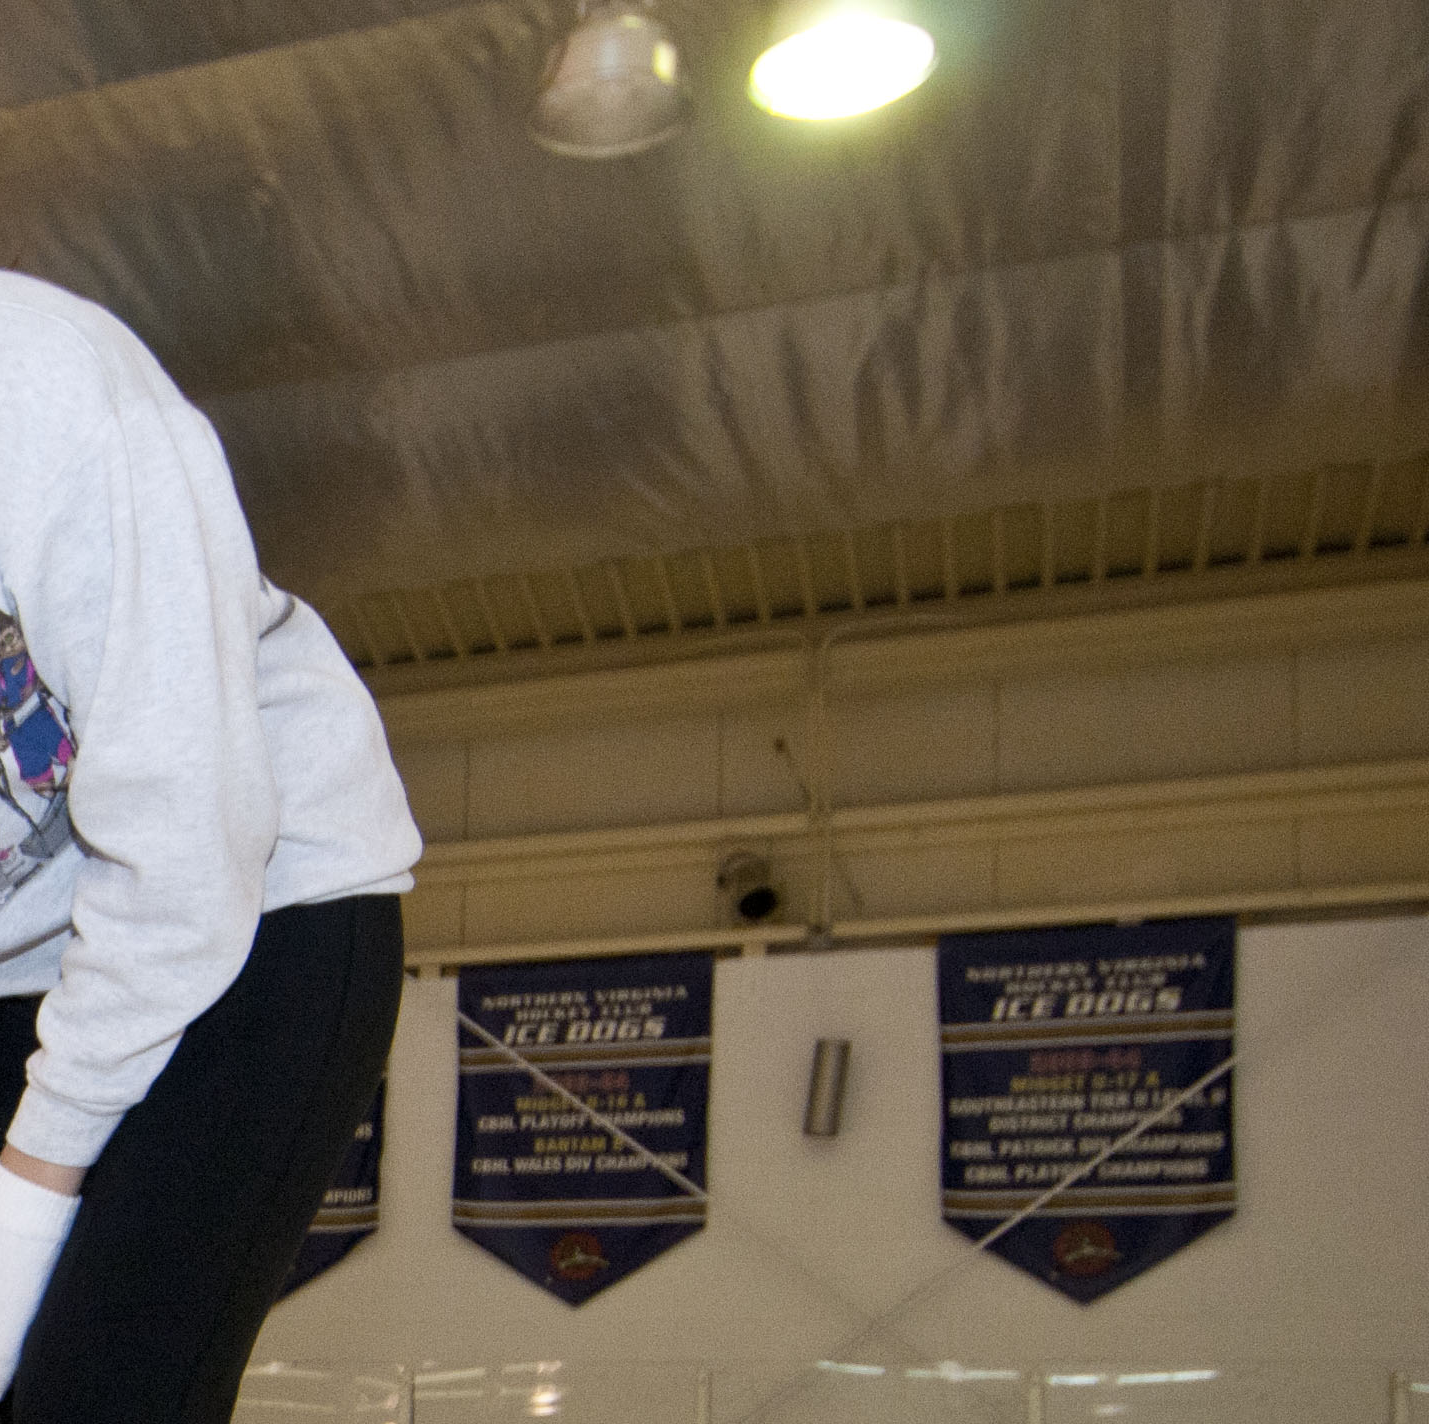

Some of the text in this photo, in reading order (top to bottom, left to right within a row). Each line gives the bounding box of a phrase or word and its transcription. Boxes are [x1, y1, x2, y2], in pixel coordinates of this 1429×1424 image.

[991, 987, 1182, 1021] ICE DOGS
[503, 1015, 666, 1046] ICE DOGS
